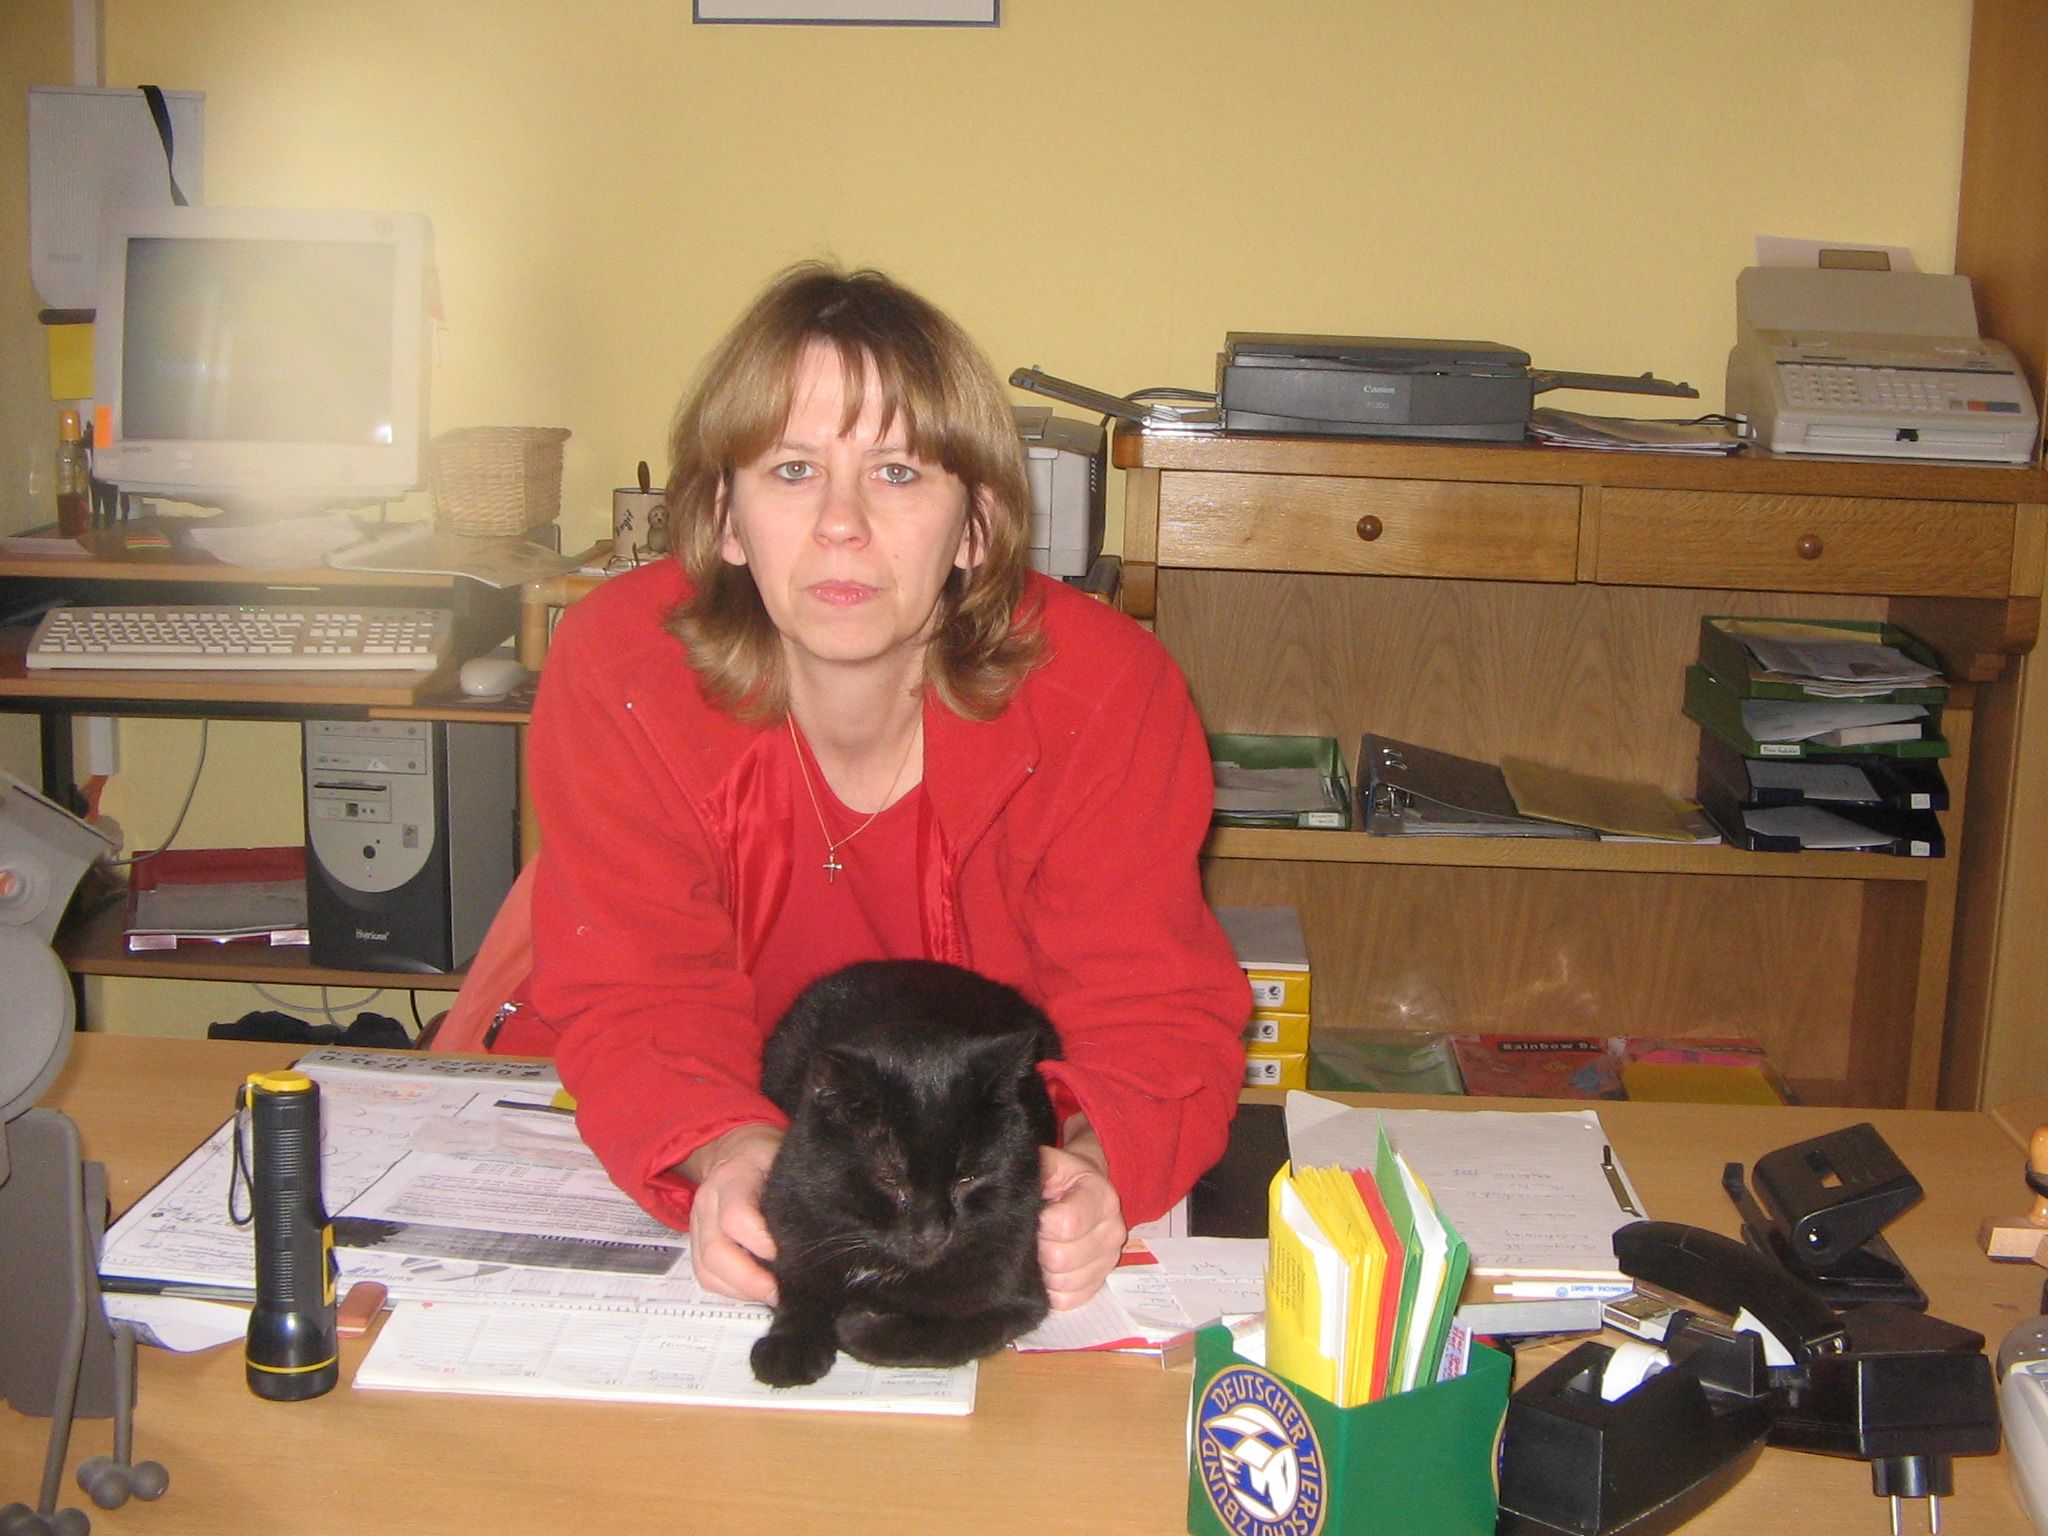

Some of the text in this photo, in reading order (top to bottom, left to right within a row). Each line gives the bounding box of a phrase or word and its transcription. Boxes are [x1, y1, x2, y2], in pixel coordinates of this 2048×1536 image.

[1363, 384, 1395, 393] Canon
[1503, 1042, 1573, 1051] Rainbow
[1211, 1374, 1307, 1444] DEUTSCHER
